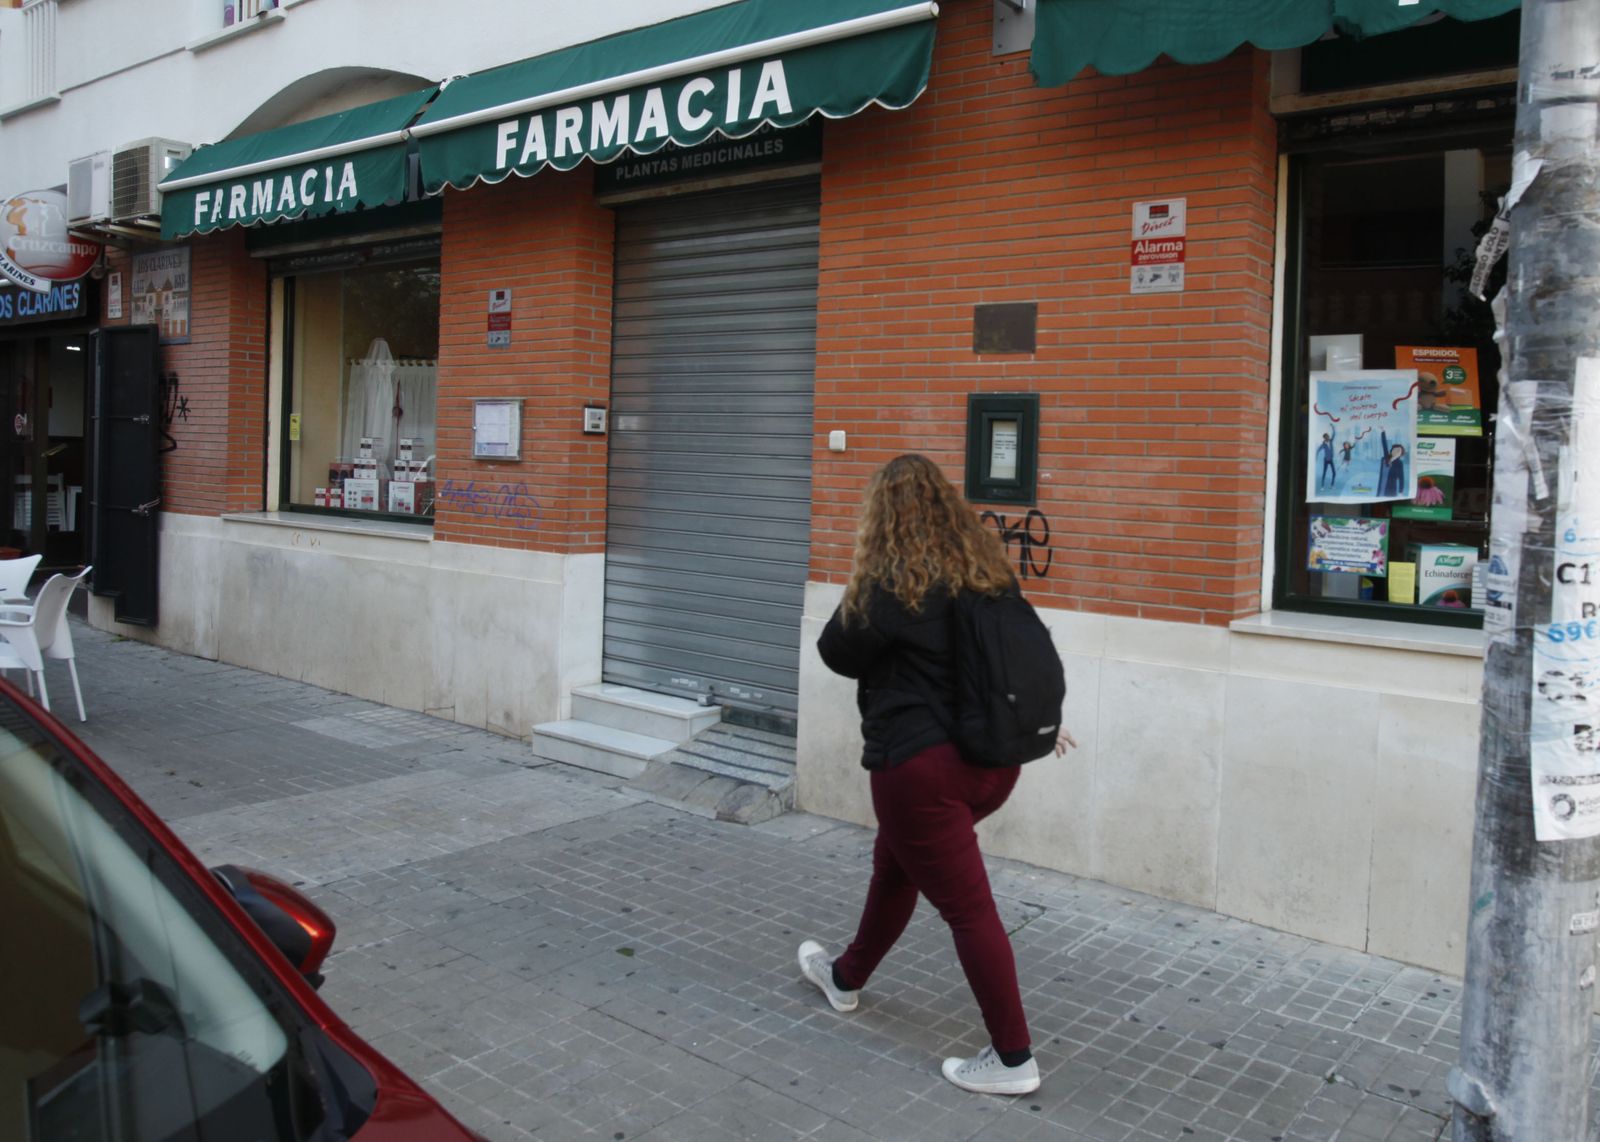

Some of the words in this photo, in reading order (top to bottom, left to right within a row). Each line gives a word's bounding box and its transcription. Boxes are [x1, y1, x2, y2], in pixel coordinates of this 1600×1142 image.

[496, 59, 793, 169] FARMACIA
[616, 159, 678, 180] PLANTAS
[681, 139, 784, 170] MEDICINALES
[195, 162, 357, 226] FARMACIA
[9, 236, 97, 257] Cruzcampo
[1134, 240, 1184, 254] Alarma
[17, 283, 80, 316] CLARINES
[1412, 349, 1460, 357] ESPIDIDOL
[1446, 370, 1454, 380] 3
[1424, 569, 1469, 579] Echinaforce
